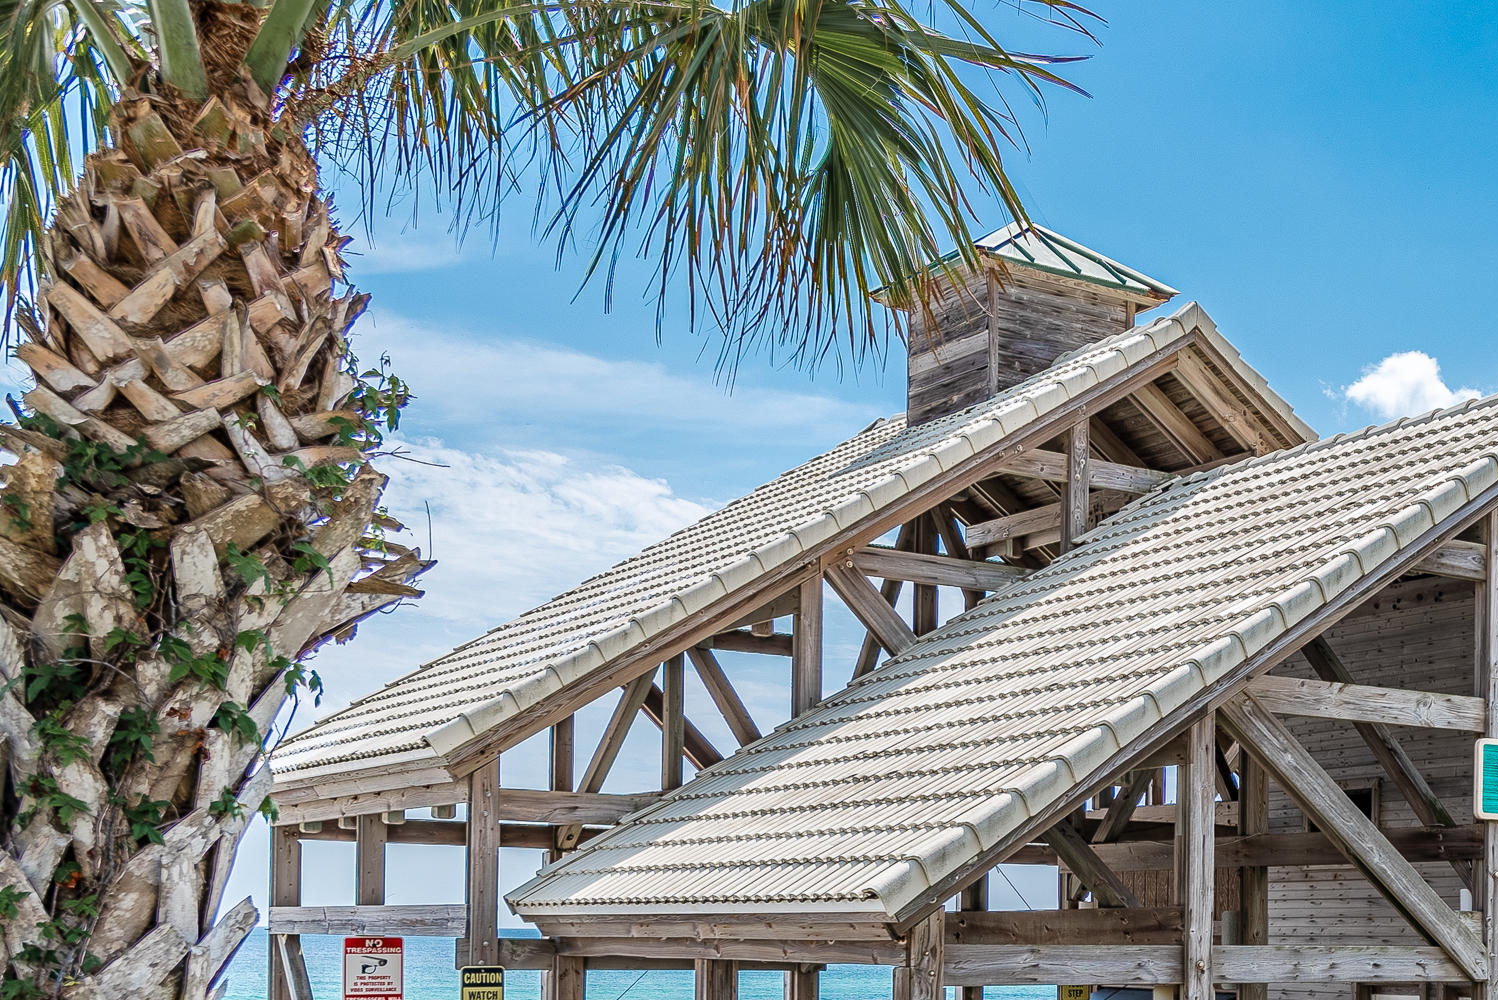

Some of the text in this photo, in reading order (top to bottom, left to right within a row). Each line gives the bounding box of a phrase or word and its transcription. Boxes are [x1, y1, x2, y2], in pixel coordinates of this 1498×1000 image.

[365, 939, 383, 947] NO
[464, 972, 502, 984] CAUTION
[468, 990, 498, 1000] WATCH
[1068, 989, 1083, 998] STEP
